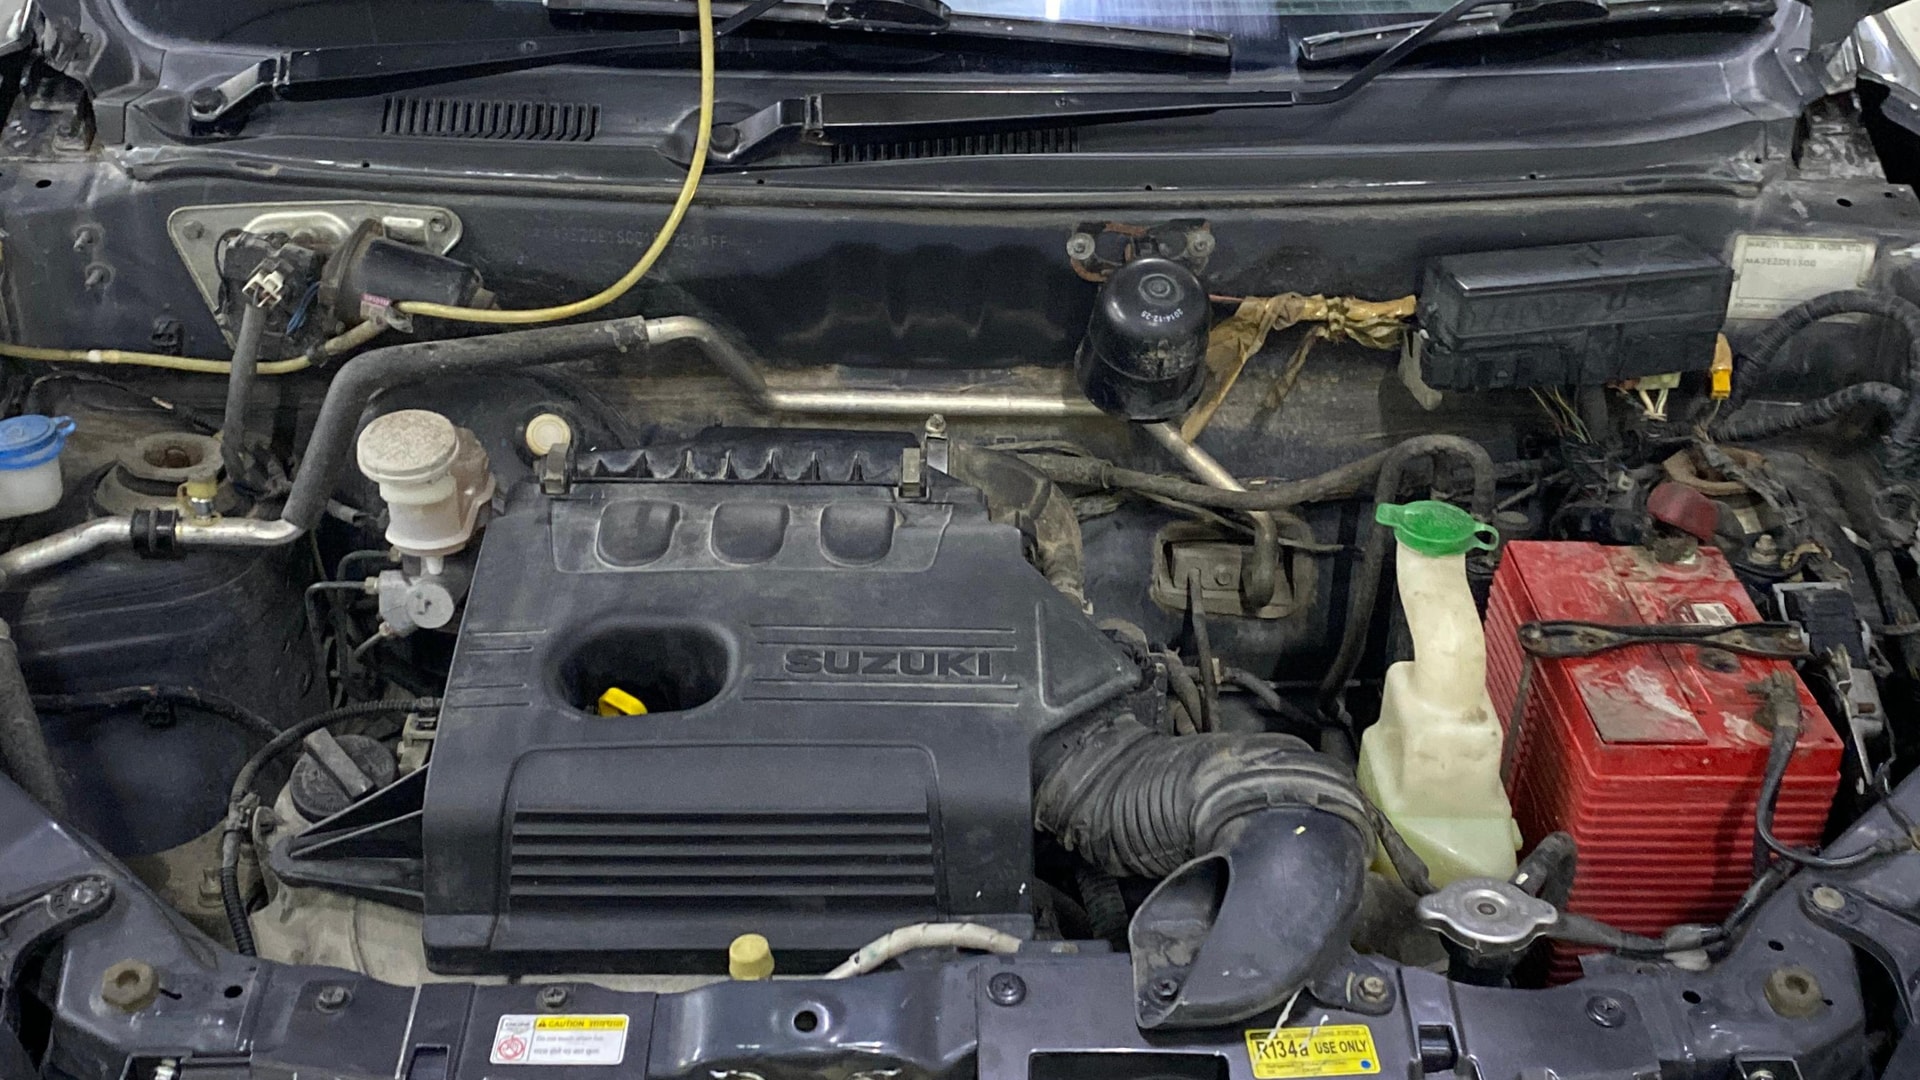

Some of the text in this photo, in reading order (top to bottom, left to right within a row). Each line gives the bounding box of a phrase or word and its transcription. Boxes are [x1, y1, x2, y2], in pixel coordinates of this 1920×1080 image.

[784, 649, 991, 677] SUZUKI
[548, 1020, 584, 1028] CAUTION
[1255, 1040, 1368, 1060] R134a USE ONLY
